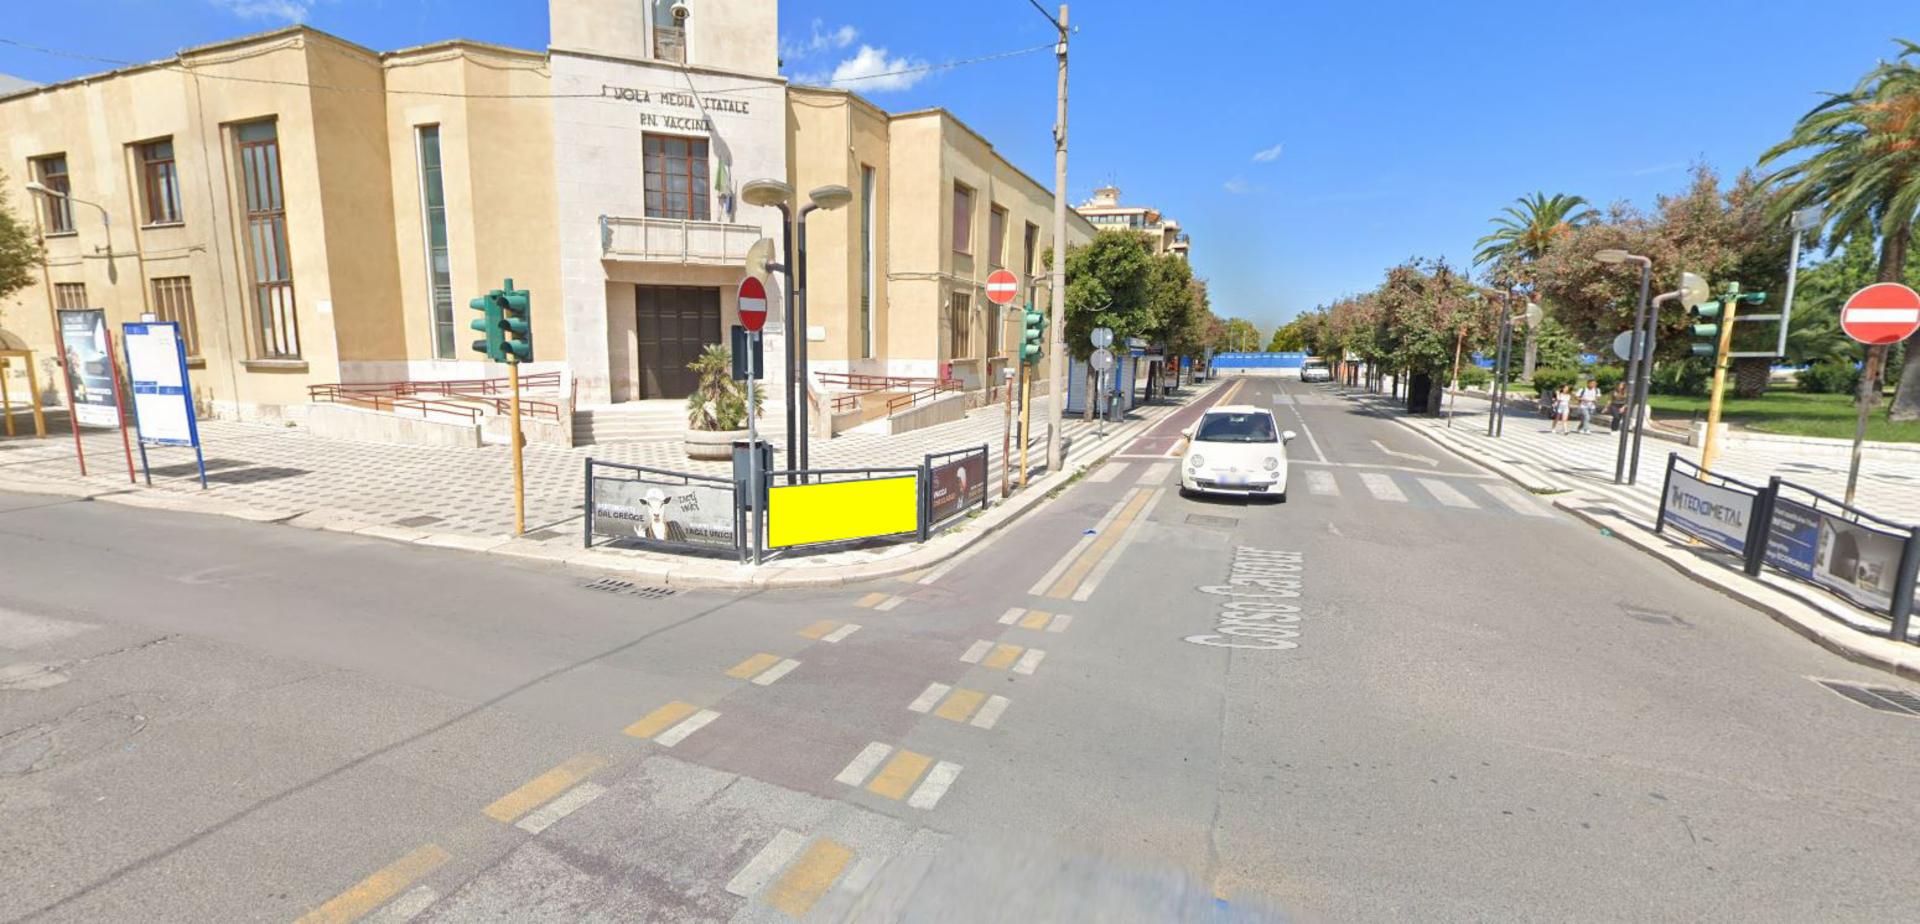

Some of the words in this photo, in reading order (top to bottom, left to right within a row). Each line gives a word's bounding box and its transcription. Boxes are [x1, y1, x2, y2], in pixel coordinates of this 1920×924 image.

[660, 92, 695, 108] MEDIA
[703, 97, 750, 114] STATALE
[663, 115, 713, 131] VACCINA
[597, 510, 612, 518] DAL
[613, 512, 645, 522] GREGGE
[709, 529, 733, 540] UNICI
